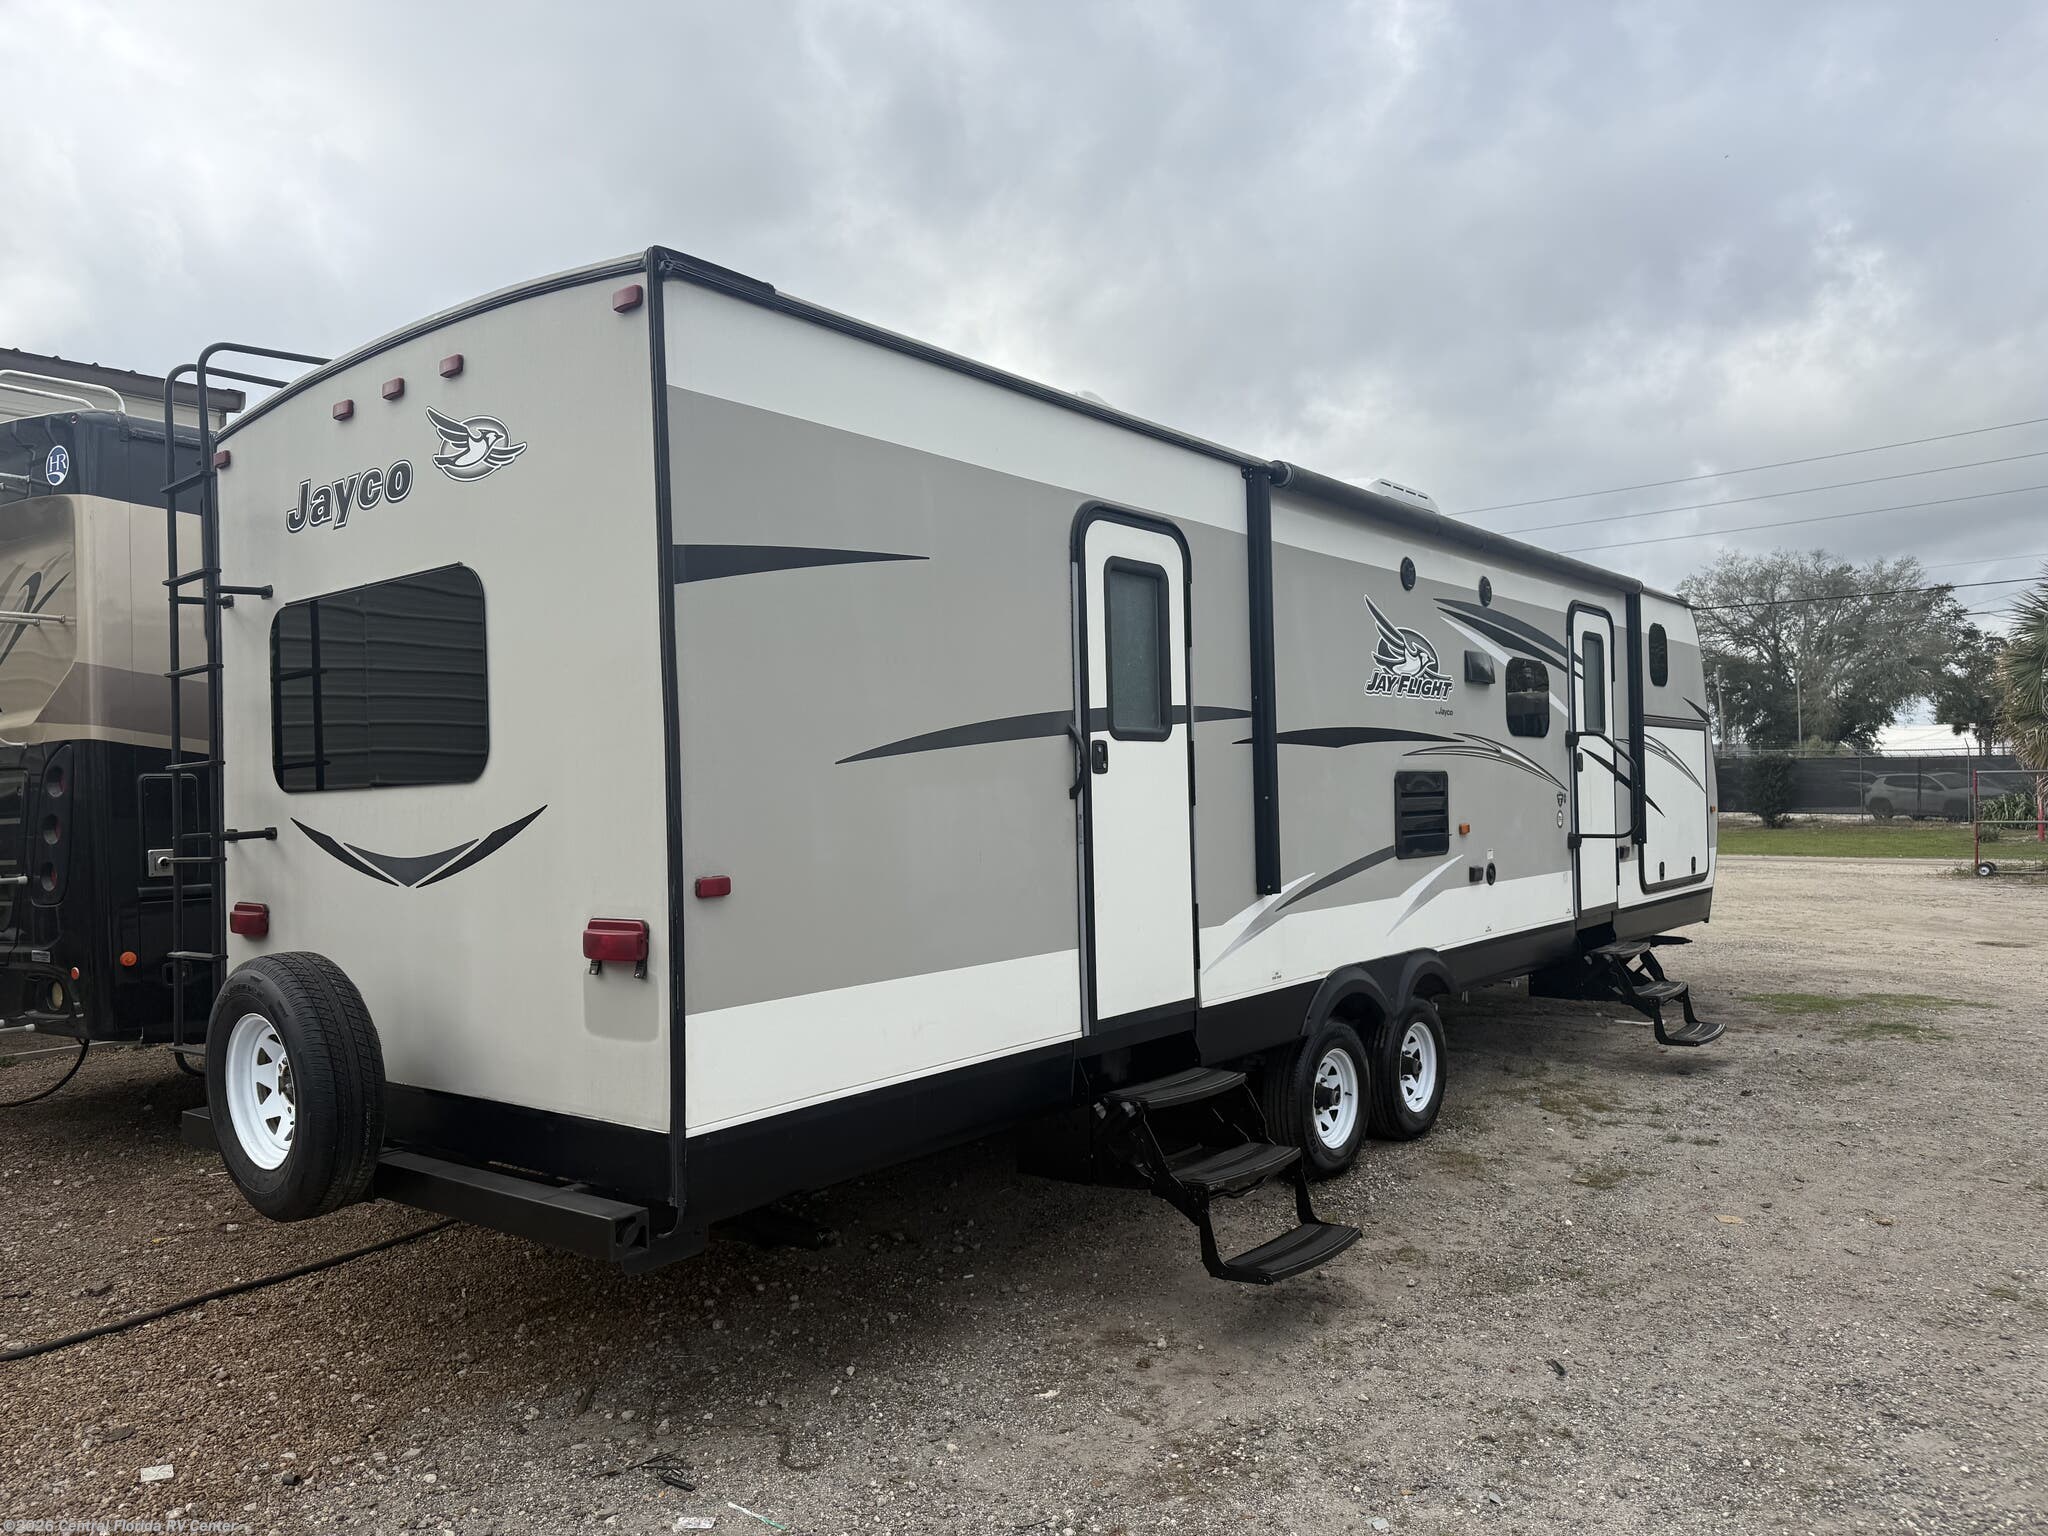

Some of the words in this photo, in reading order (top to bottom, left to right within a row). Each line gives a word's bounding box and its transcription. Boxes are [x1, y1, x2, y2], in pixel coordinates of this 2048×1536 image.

[49, 453, 67, 472] HR
[286, 459, 413, 533] Jayco
[1365, 669, 1400, 696] JAY
[1396, 674, 1454, 701] FLIGHT
